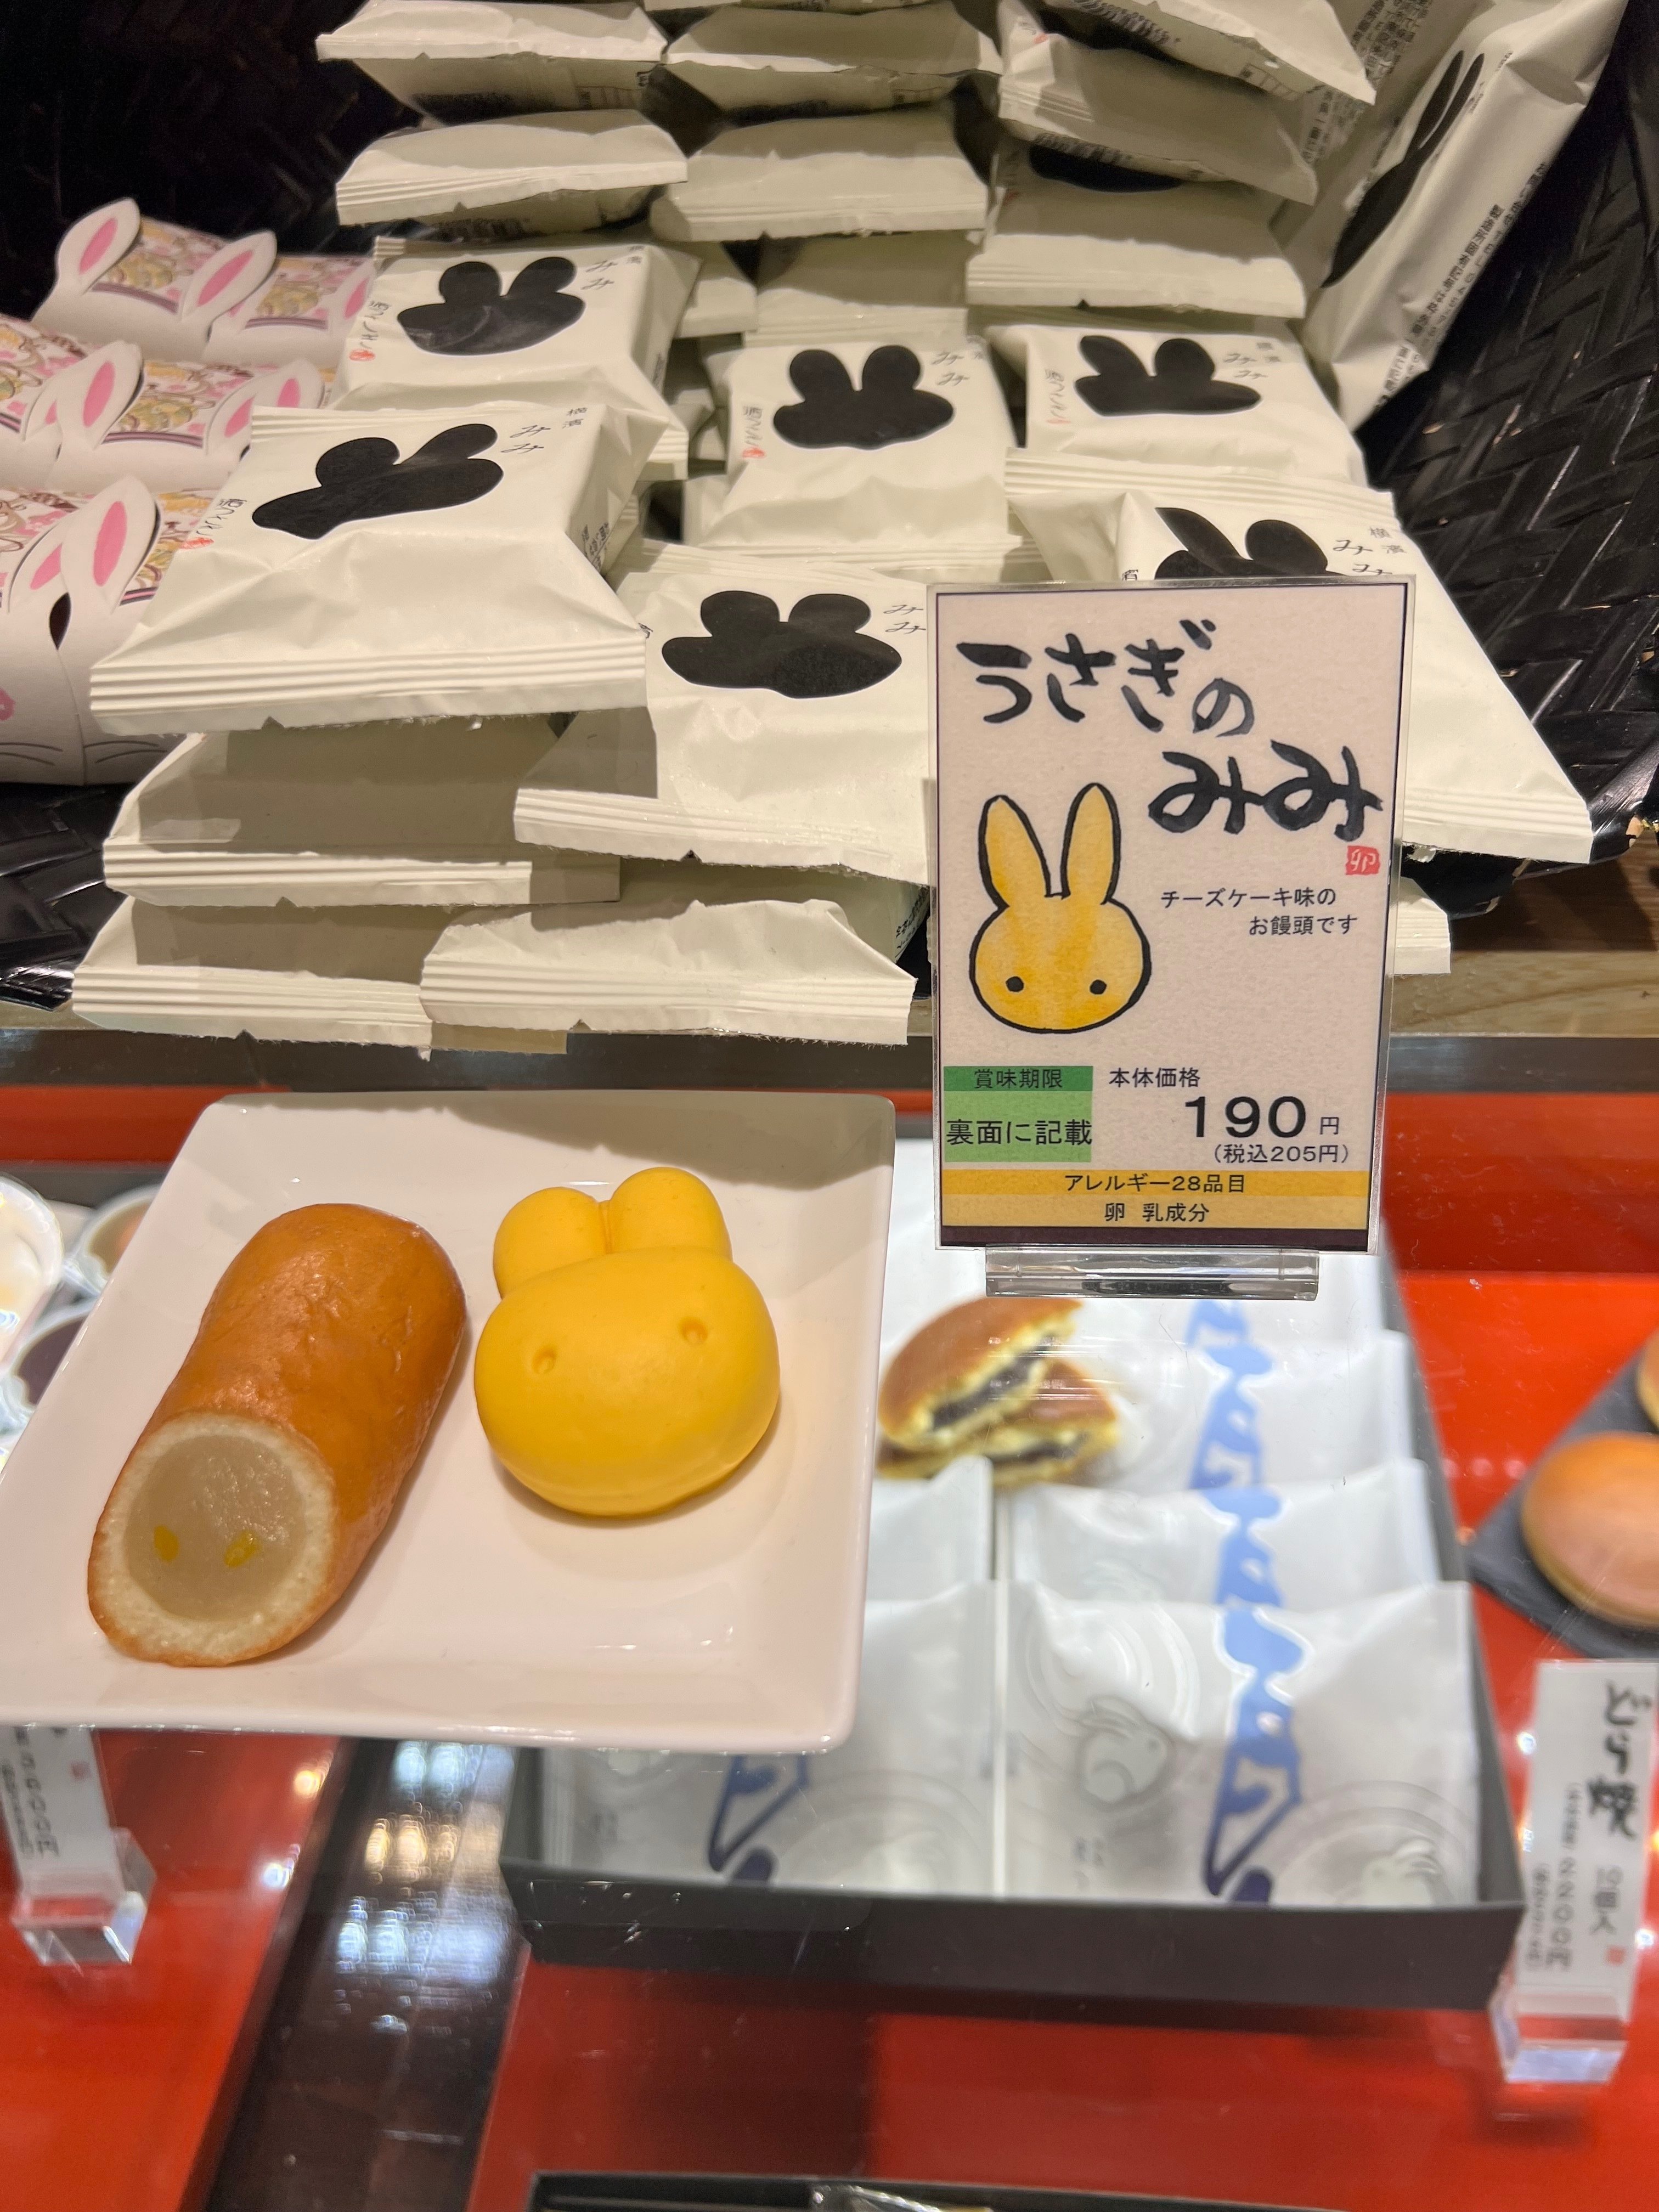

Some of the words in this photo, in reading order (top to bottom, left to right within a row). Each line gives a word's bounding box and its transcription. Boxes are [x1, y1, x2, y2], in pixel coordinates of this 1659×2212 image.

[956, 619, 1255, 737] うさぎの
[1147, 739, 1384, 842] みみ
[1161, 887, 1336, 909] チーズケーキ味の
[1249, 915, 1358, 936] お饅頭です
[974, 1068, 1063, 1089] 賞味期限
[1109, 1067, 1200, 1088] 本体価格
[1185, 1096, 1307, 1138] 190
[1319, 1116, 1340, 1135] 円
[946, 1119, 1092, 1146] 裏面に記載
[1064, 1173, 1246, 1193] アレルギー28品目
[1105, 1203, 1125, 1222] 卵
[1142, 1202, 1210, 1222] 乳成分
